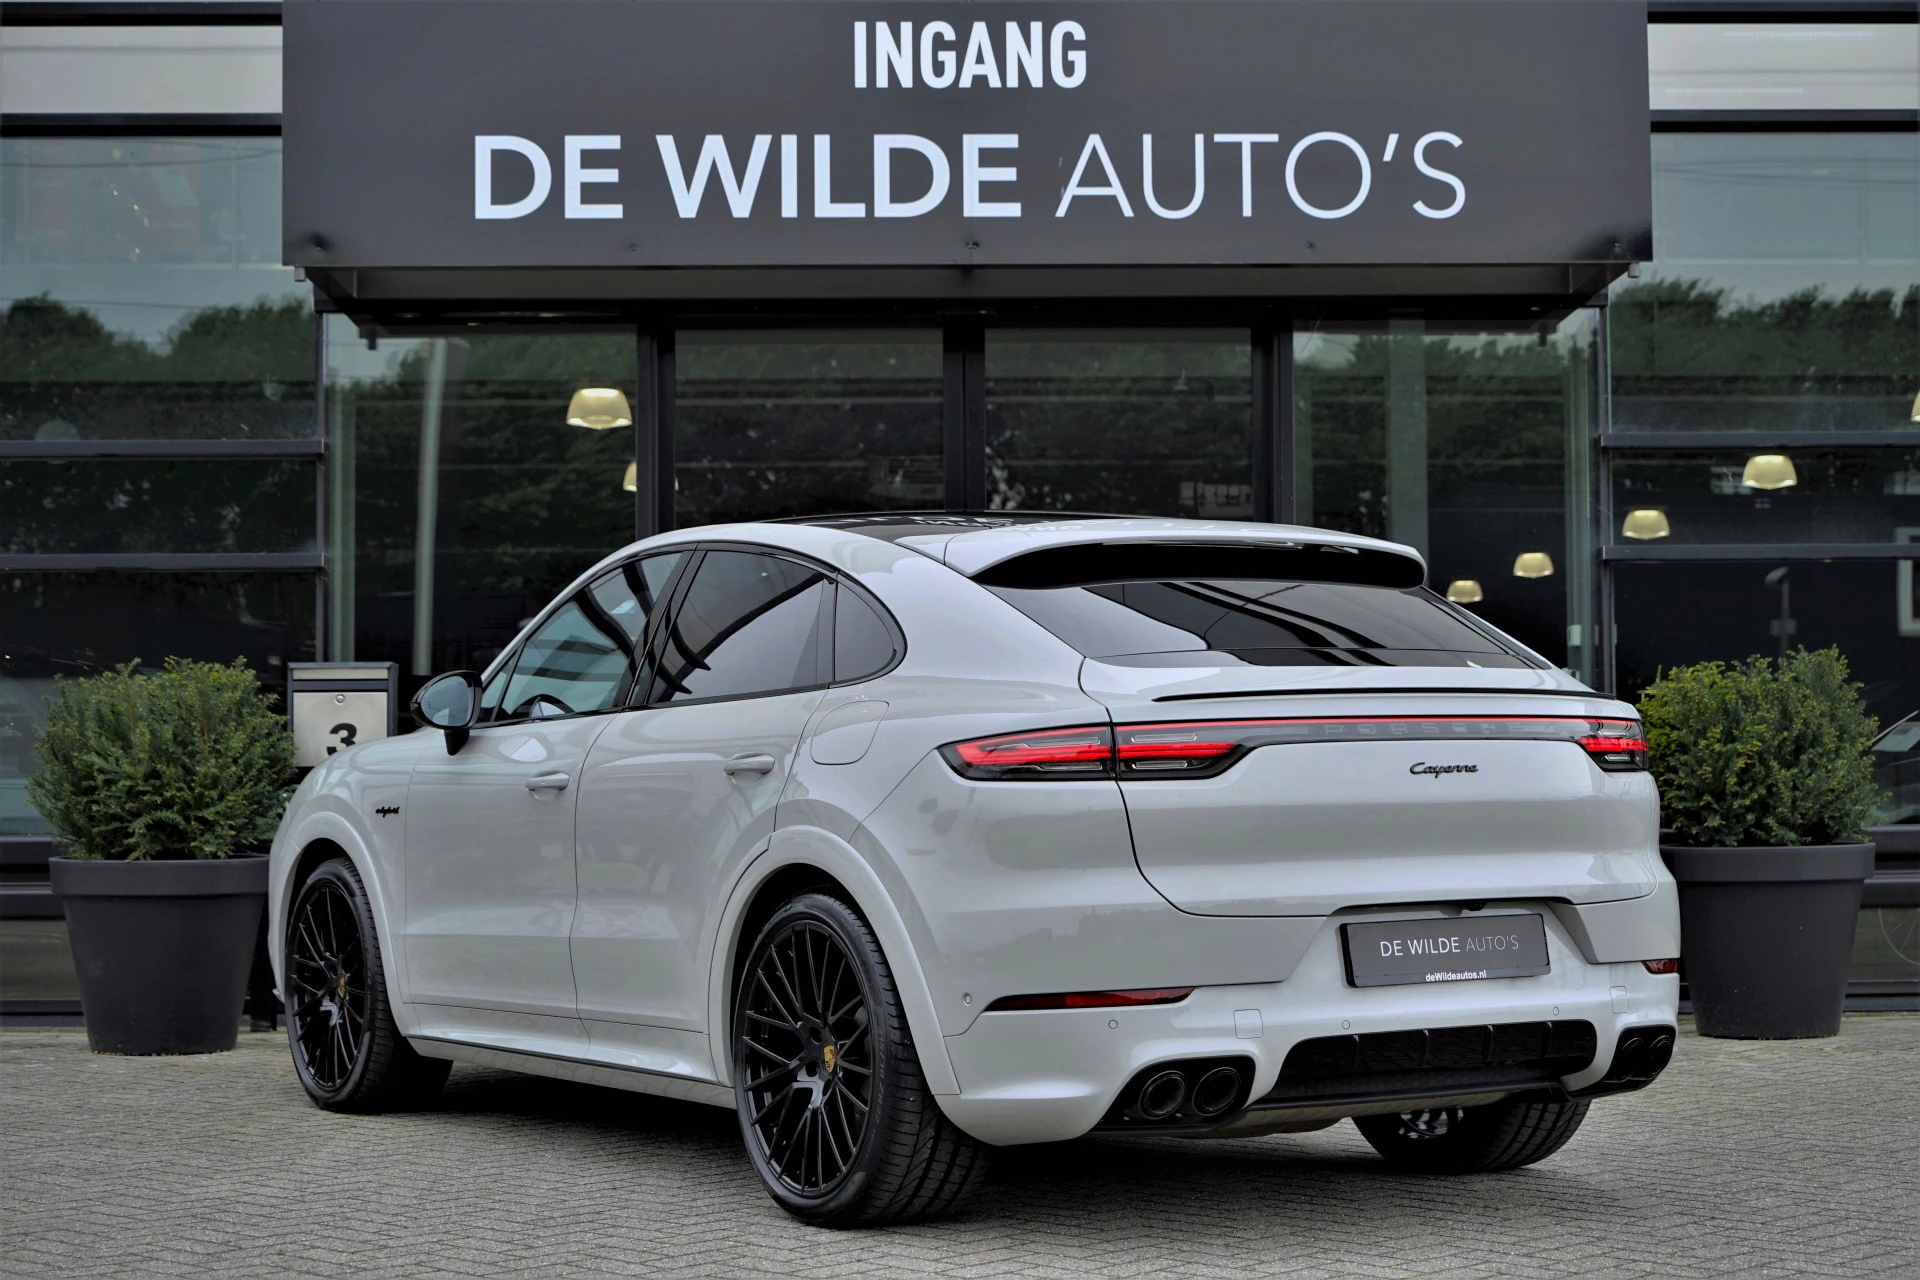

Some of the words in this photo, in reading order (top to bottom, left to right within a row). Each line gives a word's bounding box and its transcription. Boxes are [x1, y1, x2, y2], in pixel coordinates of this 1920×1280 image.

[853, 20, 1087, 89] INGANG
[474, 134, 624, 220] DE
[656, 133, 1022, 220] WILDE
[1055, 130, 1467, 220] AUTO'S
[326, 722, 357, 757] 3
[1324, 722, 1524, 736] PORSCHE
[1409, 761, 1479, 779] Cayenne
[1380, 940, 1403, 957] DE
[1407, 937, 1461, 955] WILDE
[1465, 935, 1520, 952] AUTO'S
[1425, 969, 1487, 982] deWildeautos.nl
